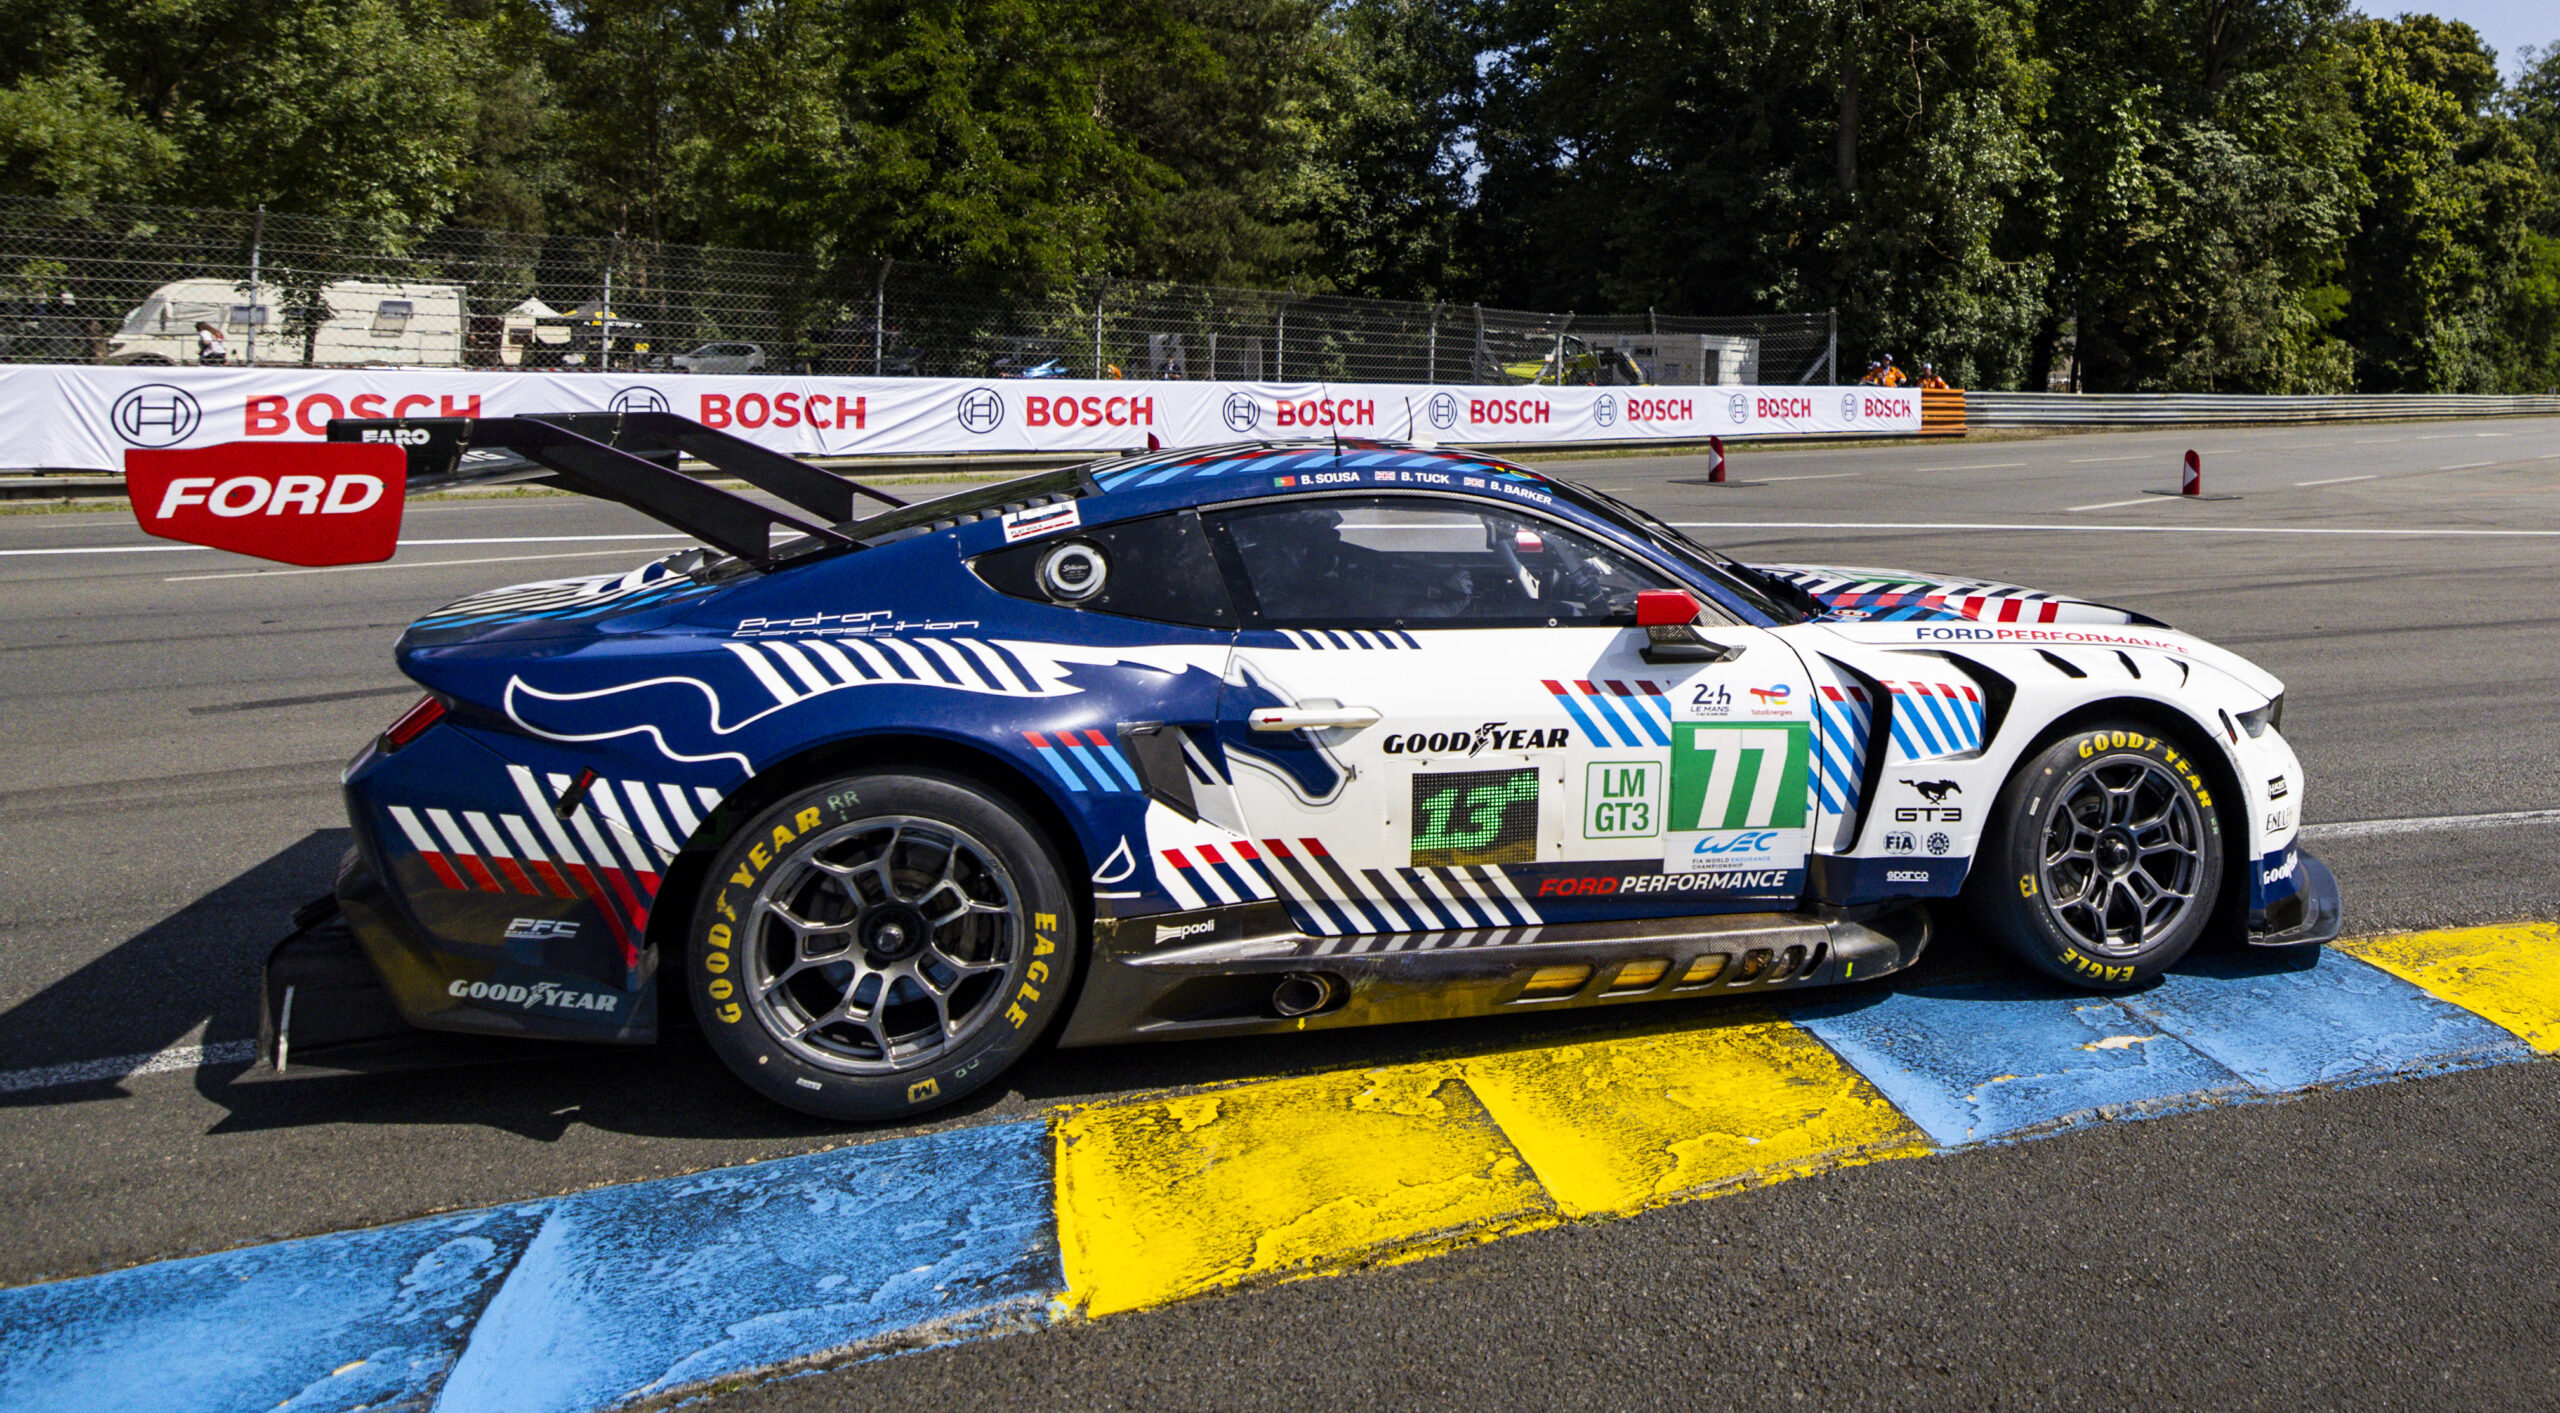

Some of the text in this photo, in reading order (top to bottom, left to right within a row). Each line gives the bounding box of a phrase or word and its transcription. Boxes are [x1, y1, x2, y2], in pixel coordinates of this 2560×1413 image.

[244, 394, 481, 436] BOSCH
[701, 392, 866, 430] BOSCH
[1026, 396, 1153, 427] BOSCH
[1277, 399, 1374, 427] BOSCH
[1470, 399, 1550, 424] BOSCH
[1628, 398, 1693, 422] BOSCH
[1757, 397, 1811, 419] BOSCH
[1865, 398, 1911, 417] BOSCH
[1301, 471, 1360, 485] B. SOUSA
[1401, 471, 1449, 484] B. TUCK
[156, 473, 384, 519] FORD
[1490, 481, 1552, 505] B. BARKER
[731, 619, 979, 637] Competition
[738, 610, 892, 630] Proton
[1703, 705, 1730, 713] MANS
[1603, 768, 1645, 799] LM
[1694, 728, 1789, 829] 77
[1594, 801, 1650, 832] GT3
[1895, 807, 1962, 822] GT3
[1694, 832, 1778, 854] WEC
[1731, 855, 1771, 863] ENDURANCE
[1538, 870, 1788, 897] FORD PERFORMANCE
[1886, 871, 1930, 882] sparco
[507, 918, 581, 934] PFC
[1182, 919, 1215, 939] paoli
[1005, 912, 1057, 1029] EAGLE
[2058, 947, 2135, 982] EAGLE
